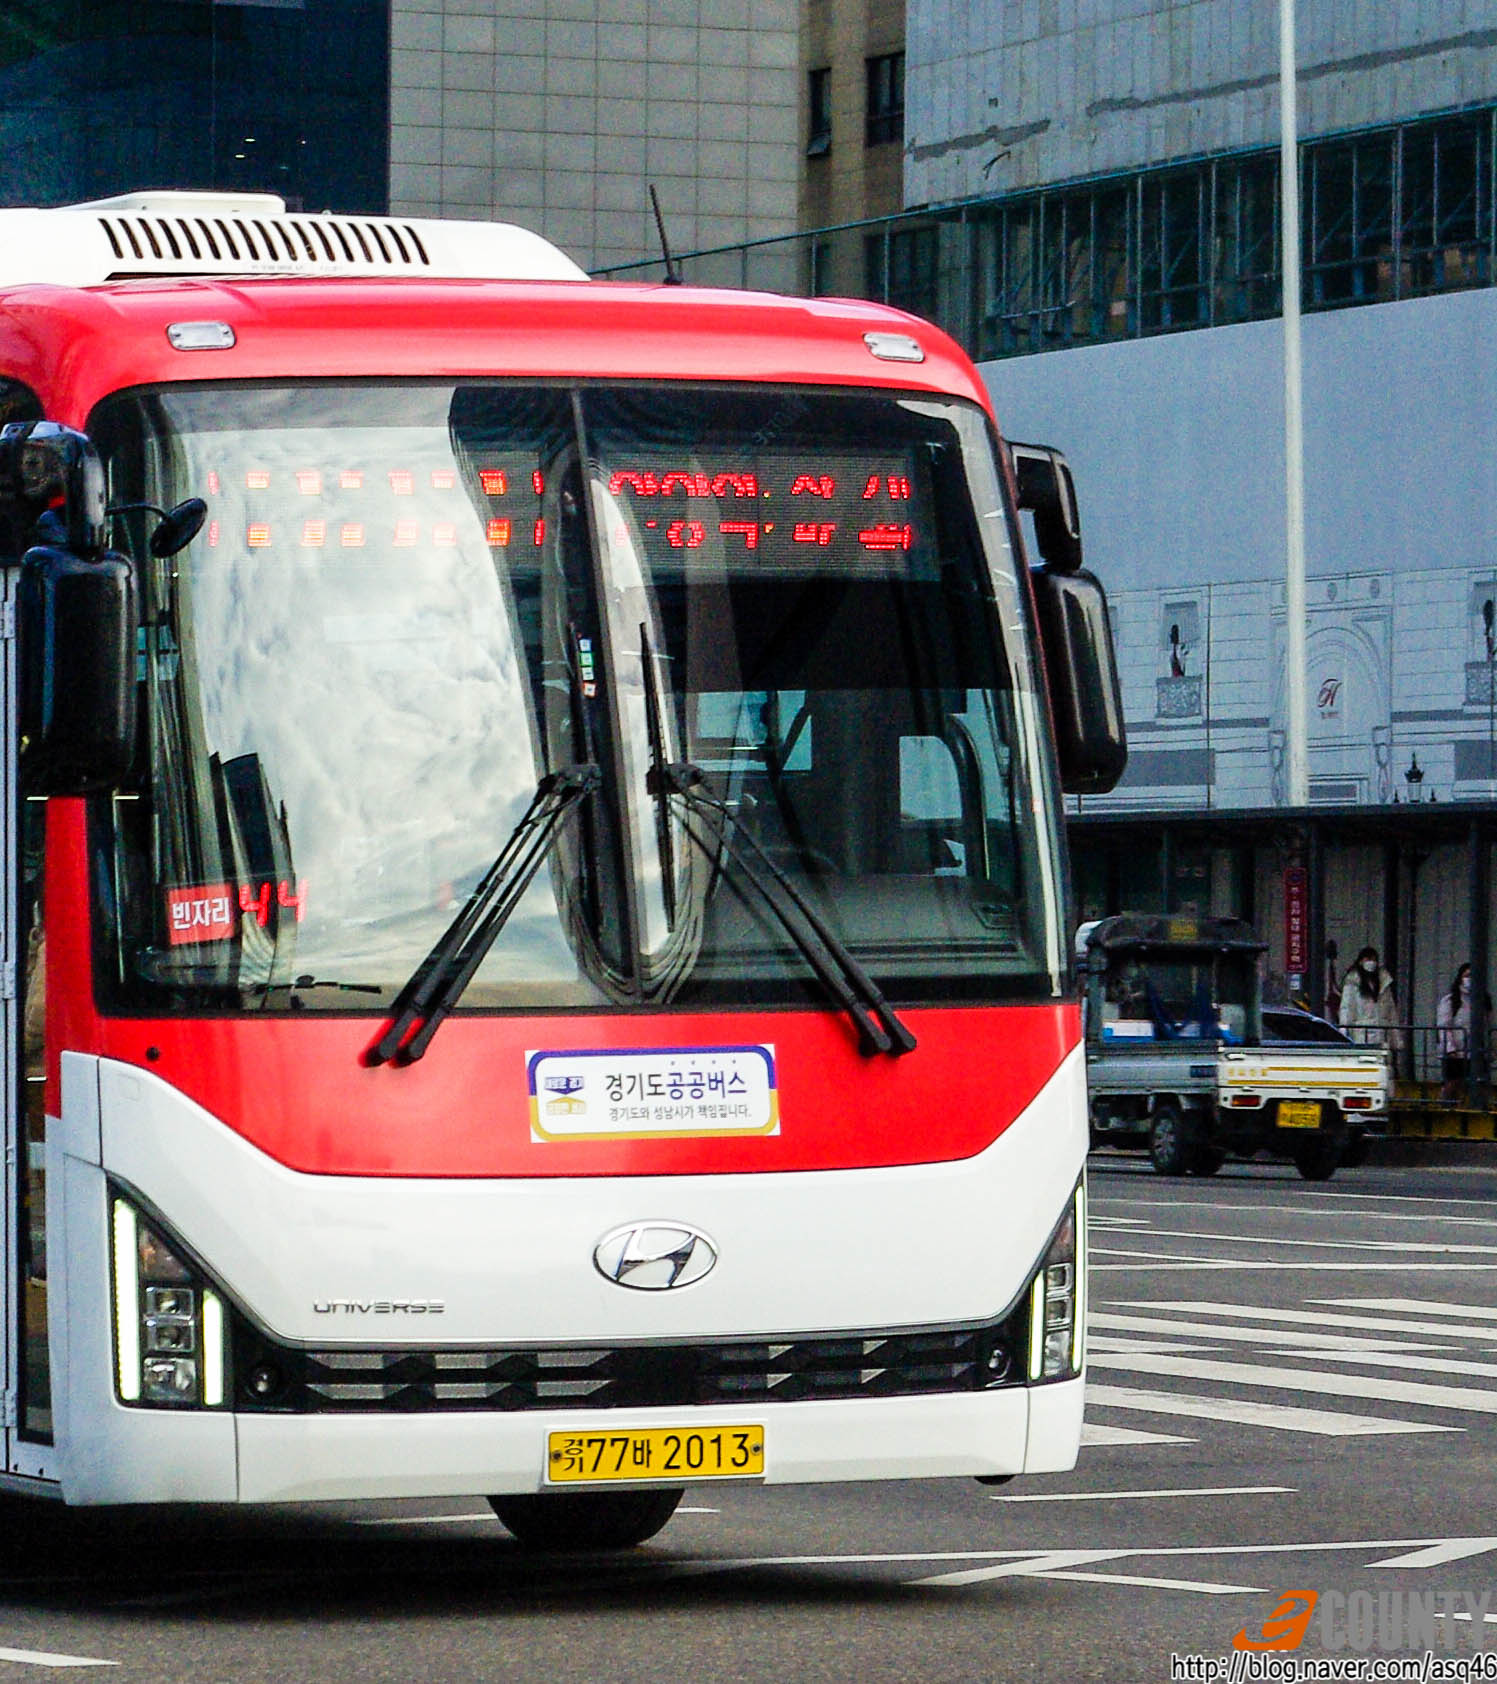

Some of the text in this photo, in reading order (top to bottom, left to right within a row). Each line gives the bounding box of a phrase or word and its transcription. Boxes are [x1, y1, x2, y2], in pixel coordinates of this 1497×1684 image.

[172, 897, 231, 929] 빈자리
[239, 880, 308, 928] 44
[605, 1071, 747, 1102] 경기도공공버스
[609, 1103, 752, 1121] 경기도와 성남시가 책임집니다.
[314, 1301, 445, 1314] UNIVERSE
[663, 1433, 750, 1470] 2013
